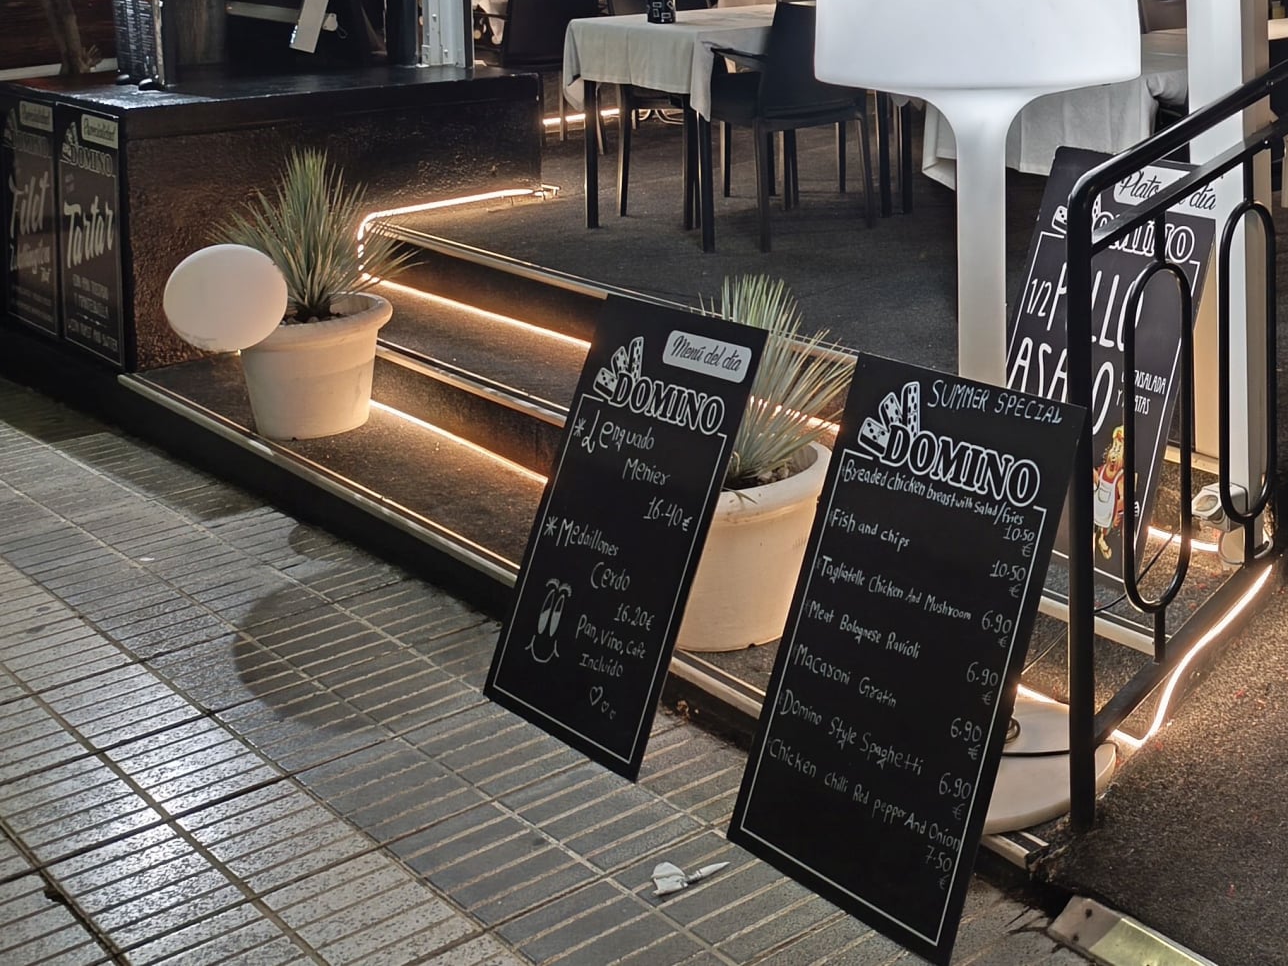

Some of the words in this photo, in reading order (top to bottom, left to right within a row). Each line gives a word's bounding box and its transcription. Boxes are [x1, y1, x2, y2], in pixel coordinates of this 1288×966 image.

[671, 335, 705, 362] Menú
[705, 345, 723, 367] del
[608, 371, 726, 435] DOMINO
[927, 379, 990, 412] SUMMER
[994, 393, 1063, 424] SPECIAL
[880, 423, 1041, 507] DOMINO
[926, 485, 956, 507] breast
[830, 509, 855, 533] Fish
[858, 522, 878, 536] and
[590, 561, 632, 592] Cerdo
[808, 600, 835, 624] Meat
[868, 574, 904, 599] Chicken
[923, 594, 972, 620] Mushroom
[780, 689, 822, 726] Domino
[769, 738, 817, 778] Chicken
[928, 823, 961, 853] Onion
